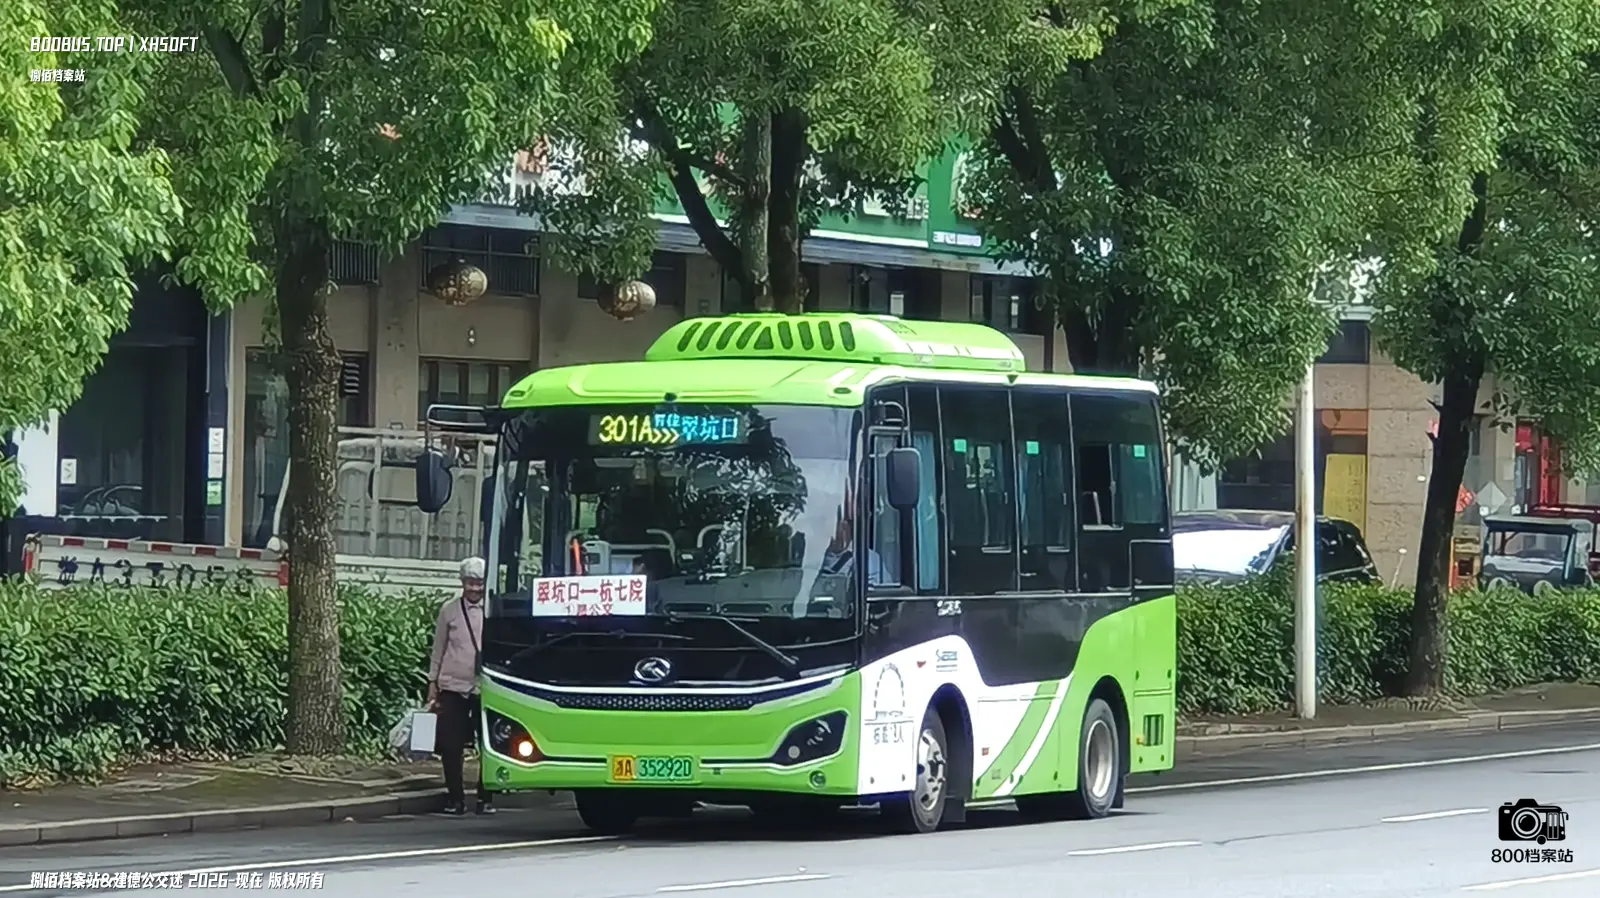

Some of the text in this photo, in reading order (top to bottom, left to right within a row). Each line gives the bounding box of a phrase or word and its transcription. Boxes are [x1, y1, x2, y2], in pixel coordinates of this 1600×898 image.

[599, 414, 653, 443] 301A
[681, 414, 738, 442] 翠坑口
[537, 578, 643, 604] 翠坑口 杭七院
[639, 759, 693, 778] 35292D
